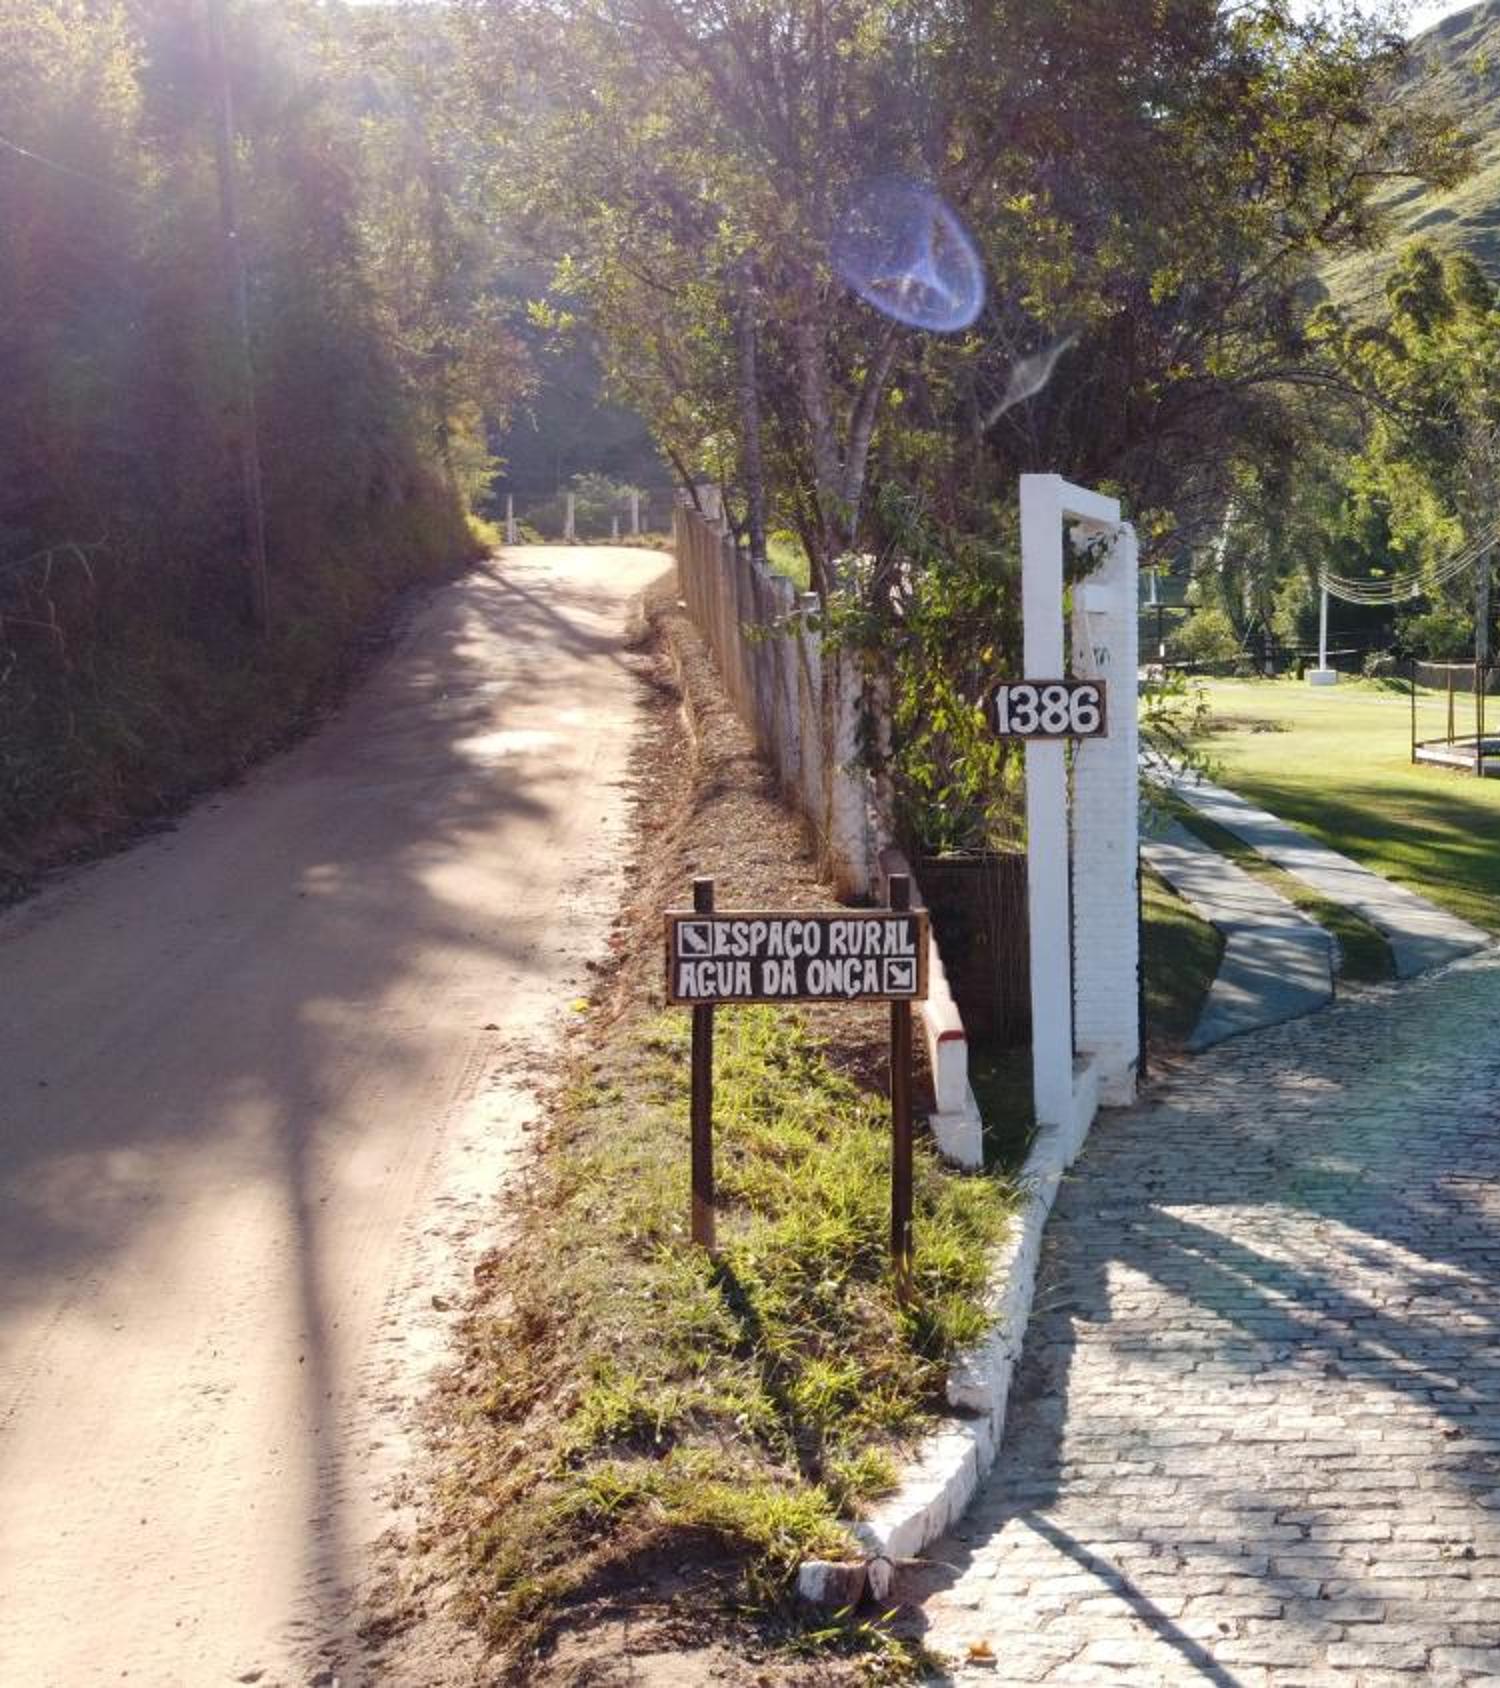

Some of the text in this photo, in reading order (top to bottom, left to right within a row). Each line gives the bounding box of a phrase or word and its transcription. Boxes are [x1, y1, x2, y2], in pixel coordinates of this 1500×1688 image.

[996, 685, 1101, 734] 1386
[713, 920, 915, 960] ESPAÇO RURAL
[678, 958, 879, 998] AGUA DA ONÇA
